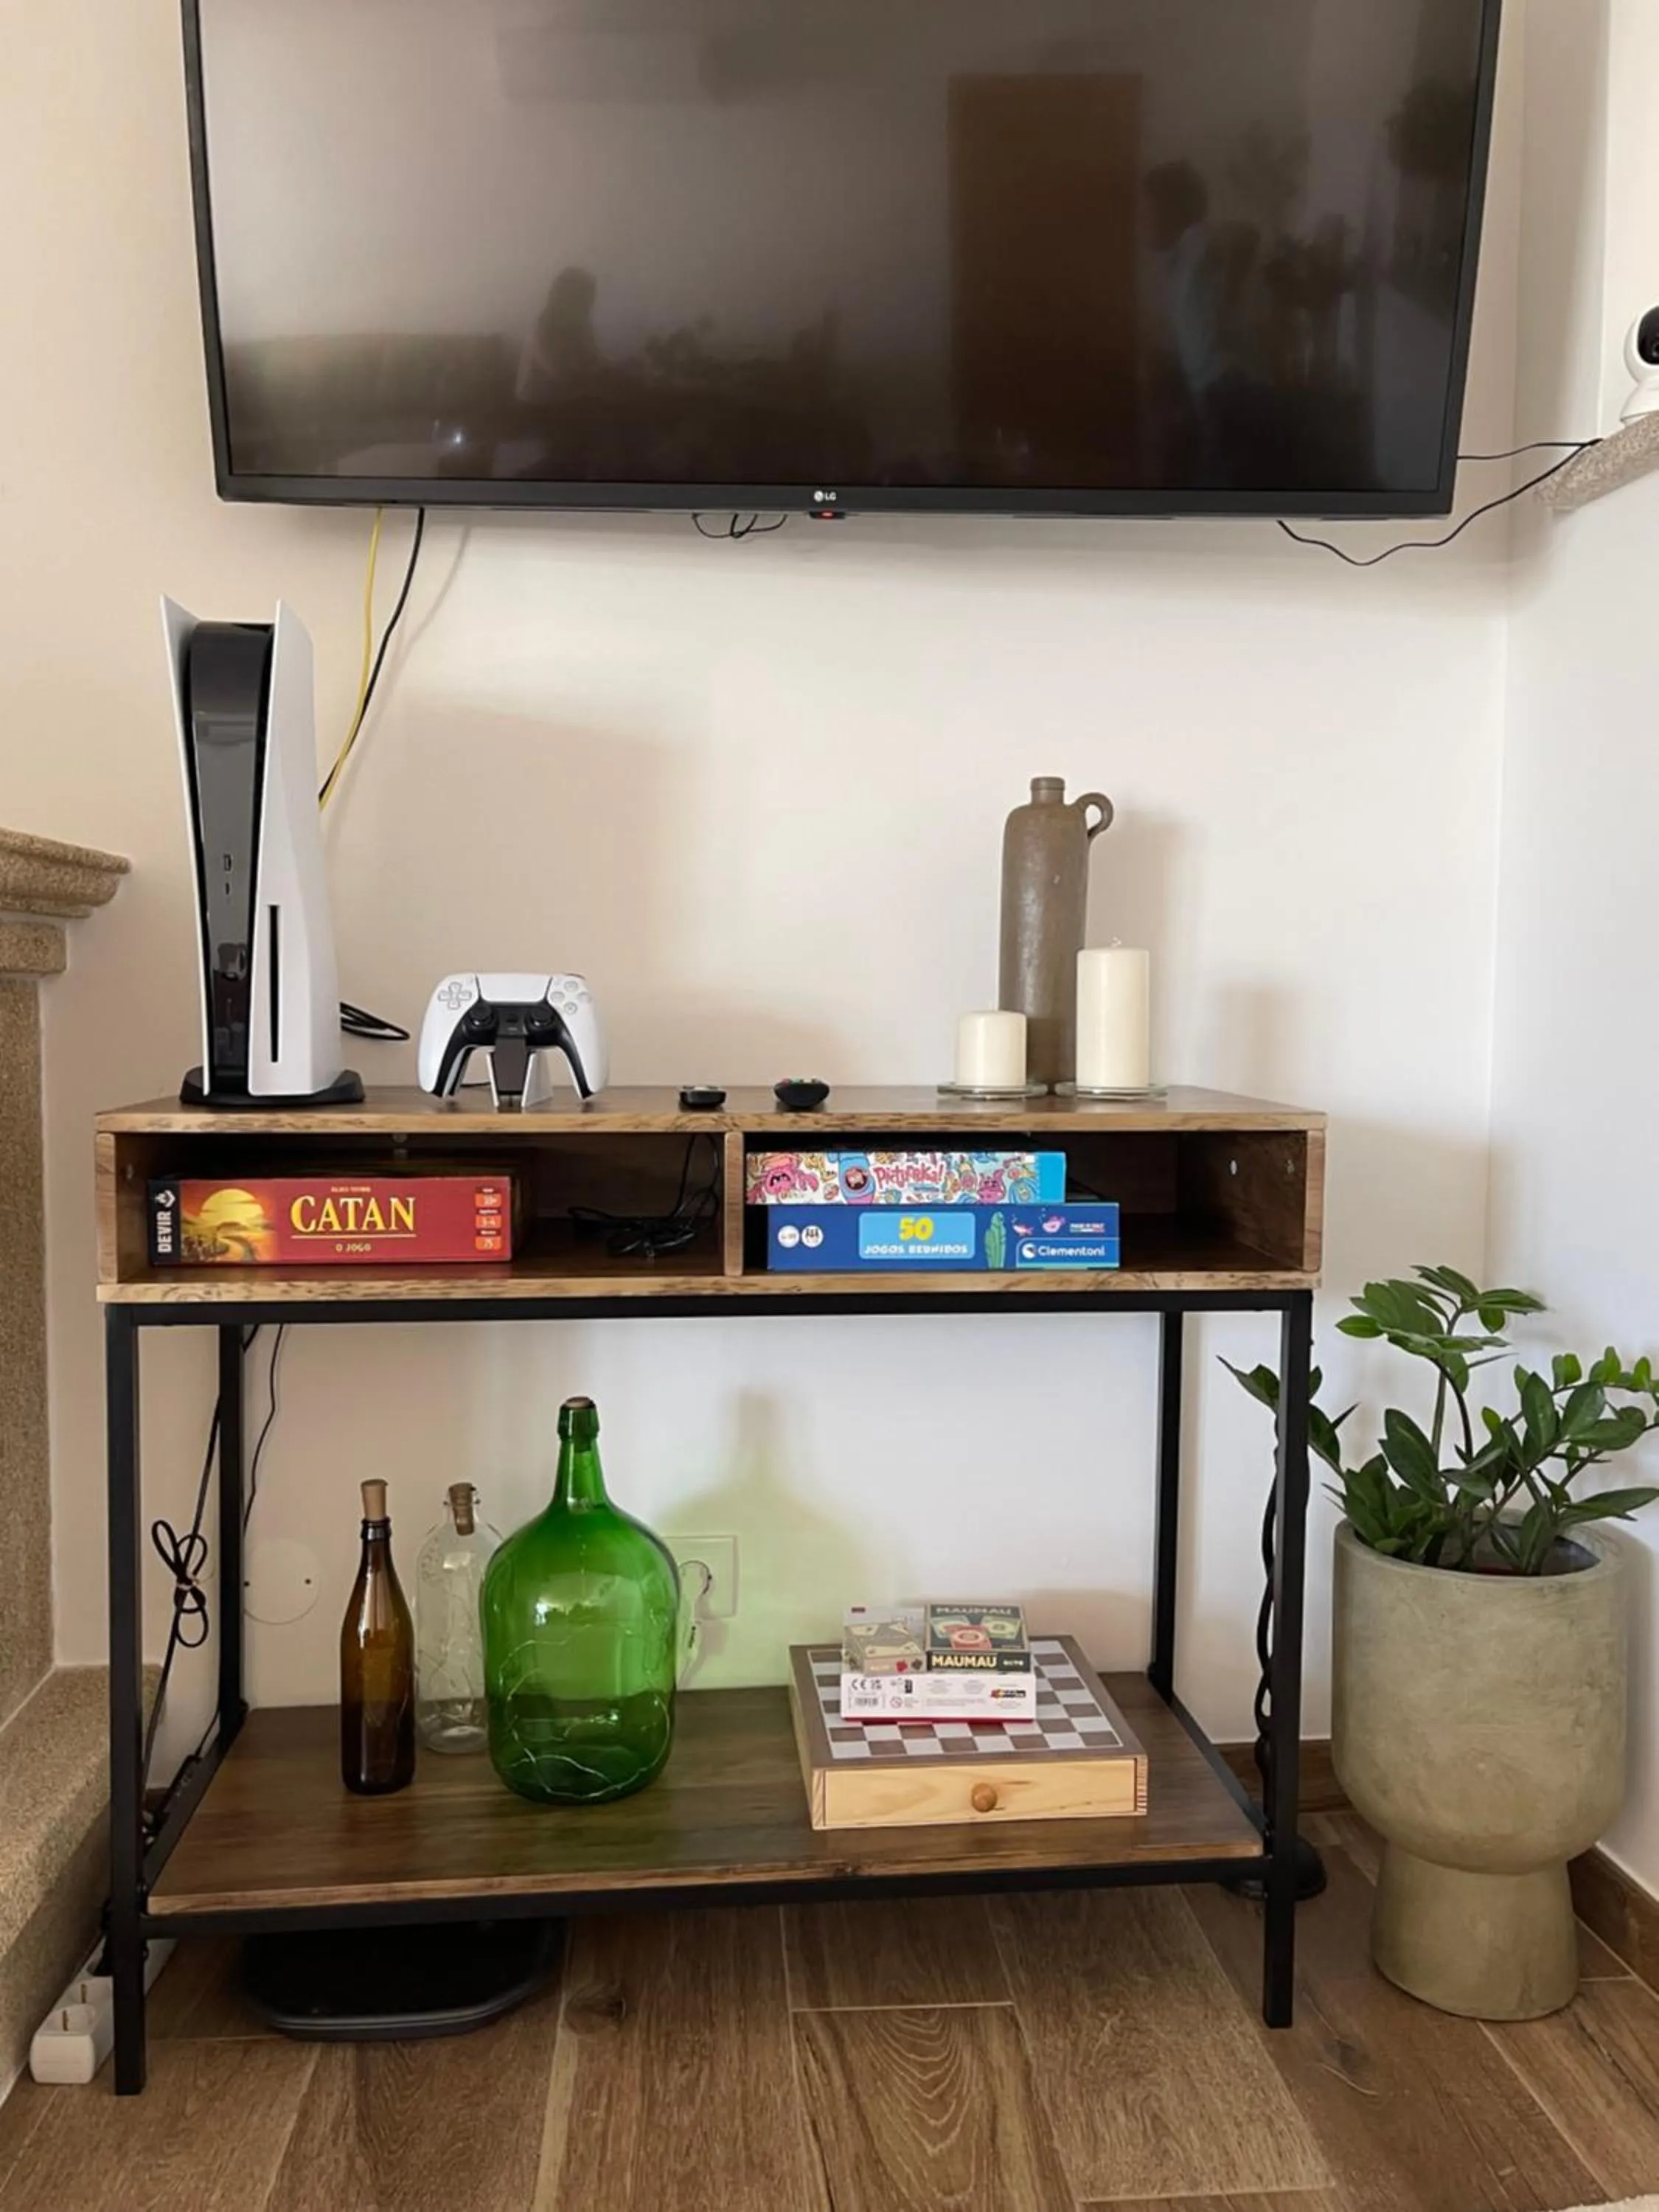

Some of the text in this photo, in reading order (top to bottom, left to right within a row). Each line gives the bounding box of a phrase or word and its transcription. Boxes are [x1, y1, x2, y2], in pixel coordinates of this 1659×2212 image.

[291, 1195, 416, 1233] CATAN
[156, 1211, 173, 1253] DEVIR
[899, 1217, 934, 1242] 50
[345, 1242, 372, 1252] JOGO
[865, 1243, 905, 1254] JOGOS
[1037, 1245, 1105, 1256] Clementoni
[931, 1655, 997, 1667] MAUMAU
